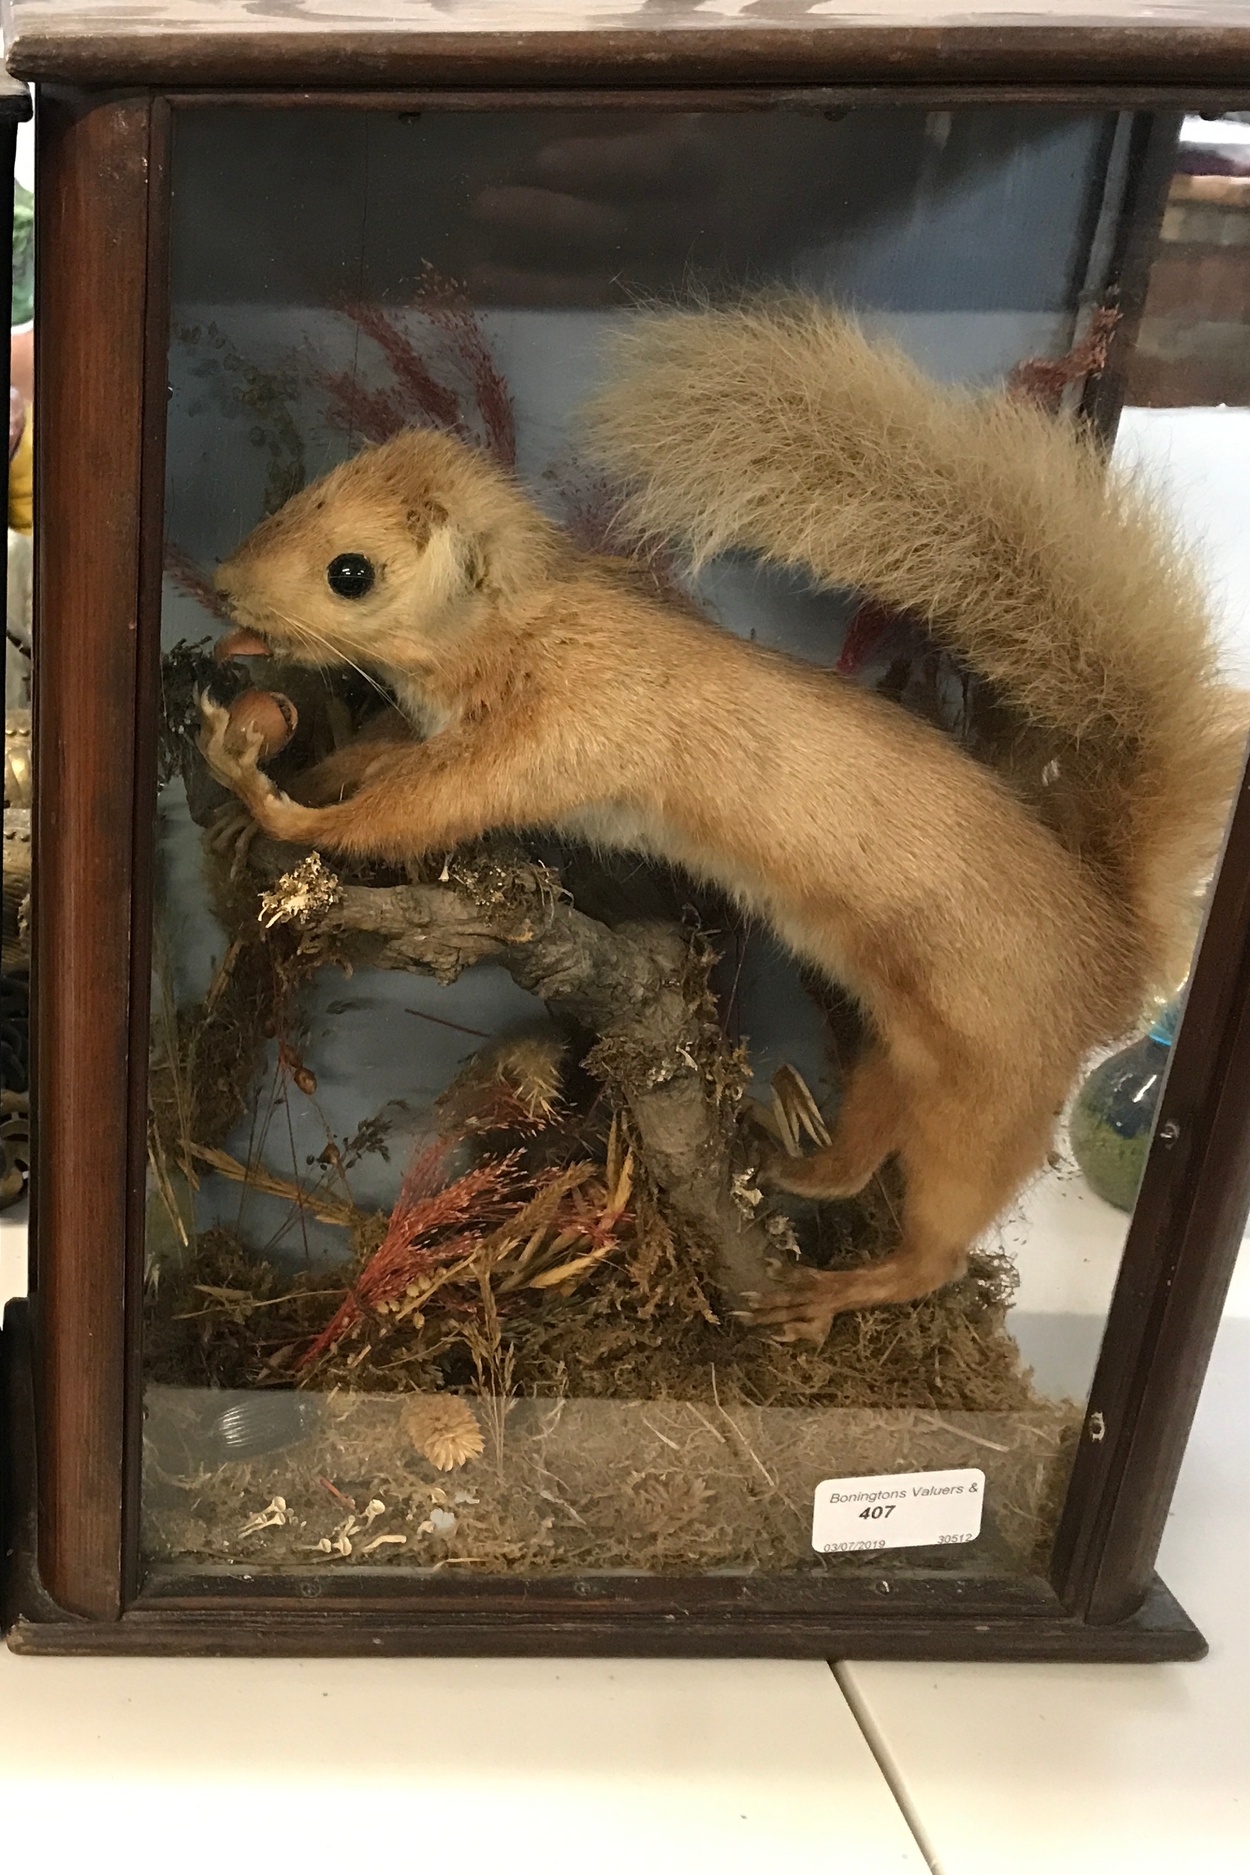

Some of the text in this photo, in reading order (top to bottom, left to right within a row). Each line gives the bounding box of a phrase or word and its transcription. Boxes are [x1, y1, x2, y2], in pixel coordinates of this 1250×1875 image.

[830, 1482, 979, 1503] Boningtons Valuers &
[859, 1505, 896, 1520] 407
[823, 1540, 886, 1553] 03/07/2019
